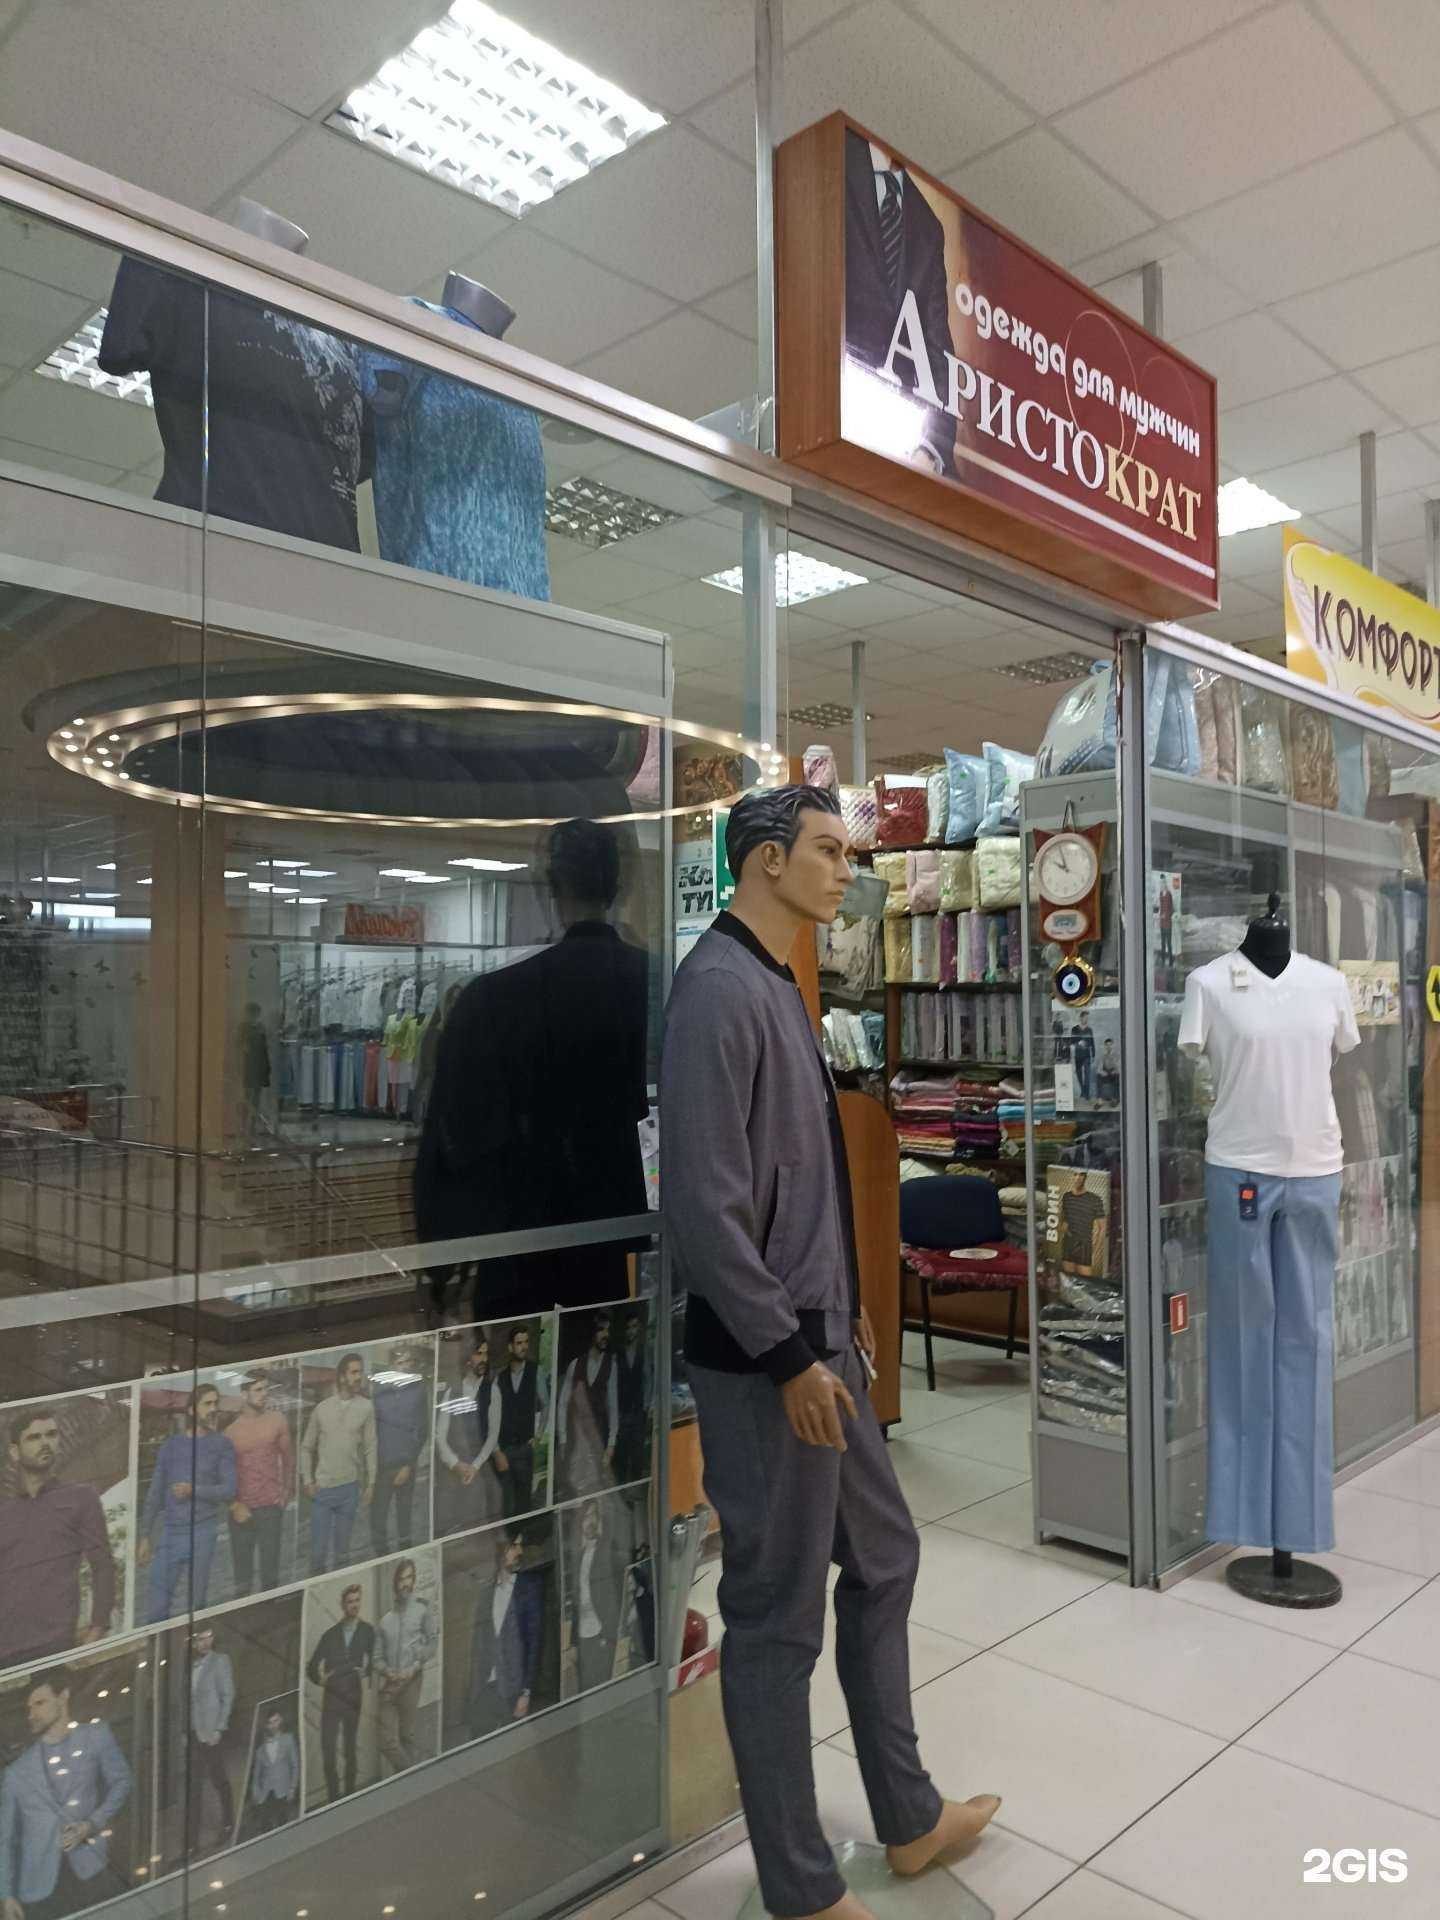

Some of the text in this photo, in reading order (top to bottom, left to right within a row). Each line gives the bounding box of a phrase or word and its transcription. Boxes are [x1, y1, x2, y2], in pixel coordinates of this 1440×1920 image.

[955, 283, 1200, 457] одежда для мужчин
